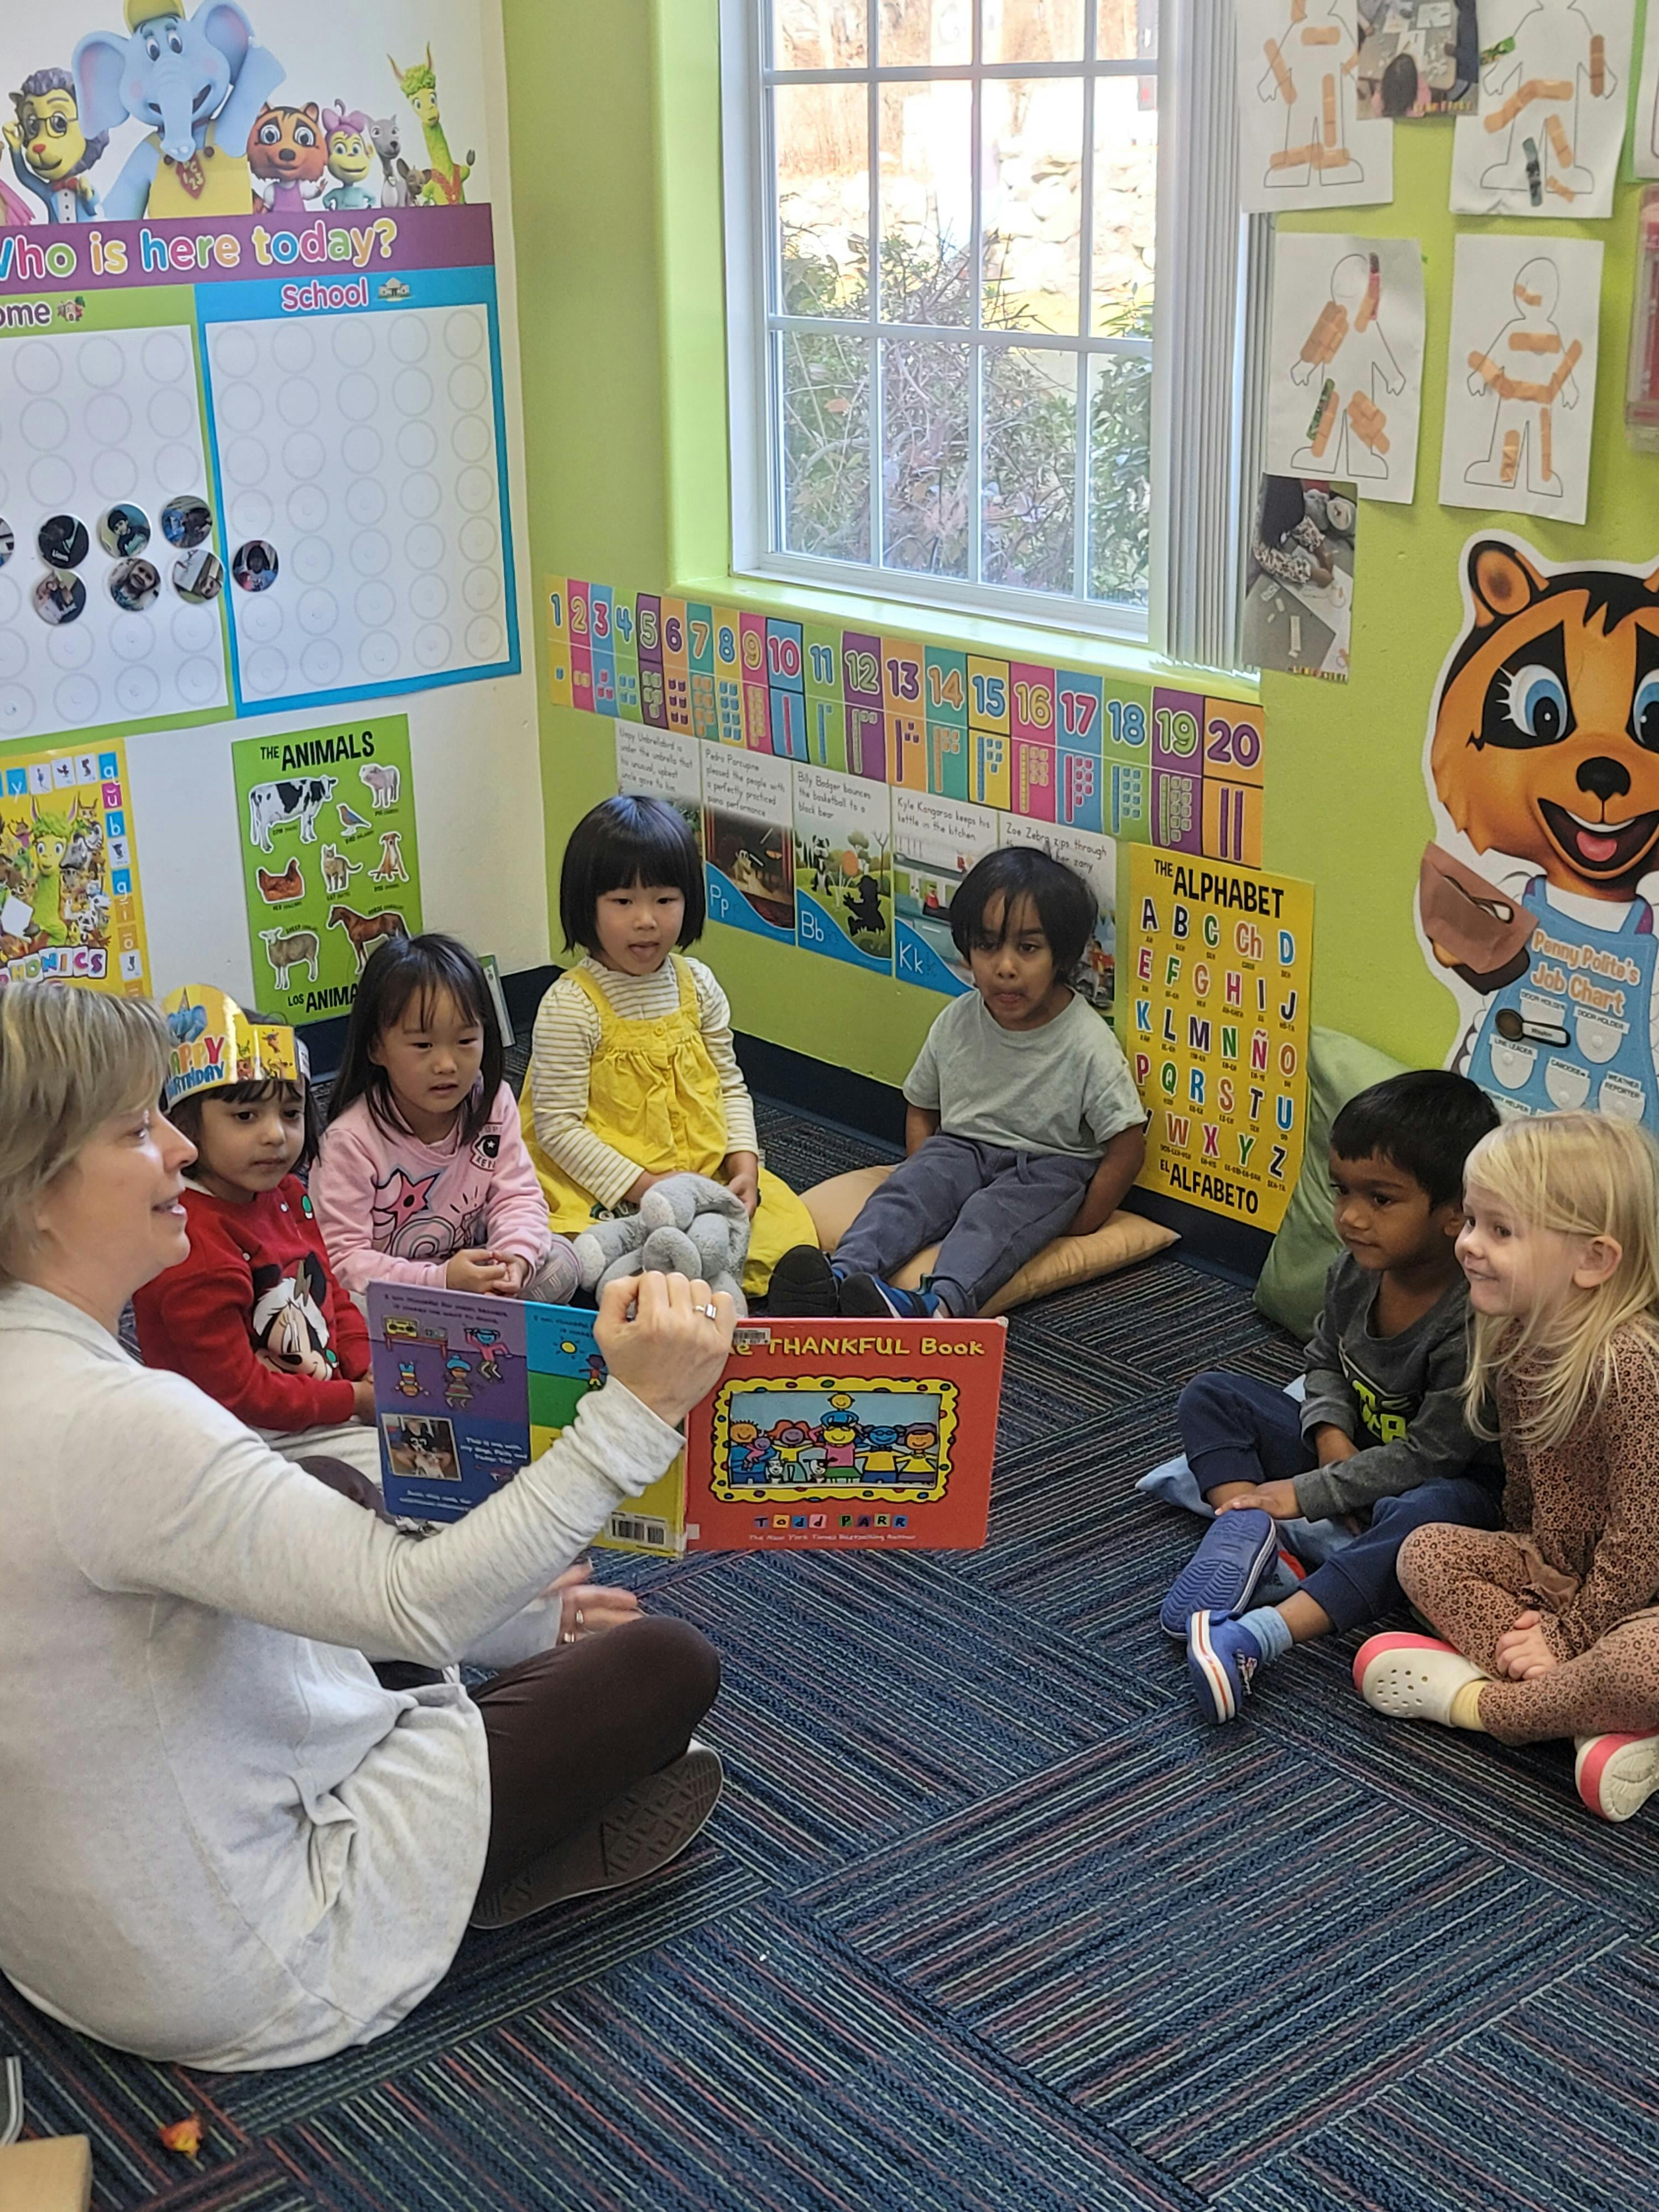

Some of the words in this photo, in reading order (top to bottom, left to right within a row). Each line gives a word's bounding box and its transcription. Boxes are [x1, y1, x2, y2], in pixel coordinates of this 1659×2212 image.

[0, 235, 77, 281] ho
[90, 232, 128, 275] is
[140, 228, 241, 272] here
[251, 218, 398, 268] today?
[281, 277, 368, 311] School
[551, 593, 562, 627] 1
[571, 596, 587, 634] 2
[593, 601, 609, 638] 3
[616, 606, 632, 643] 4
[640, 611, 659, 649] 5
[665, 616, 682, 653] 6
[690, 621, 709, 659] 7
[719, 627, 735, 664] 8
[742, 630, 762, 670] 9
[768, 635, 801, 677] 10
[810, 644, 834, 686] 11
[845, 650, 879, 695] 12
[886, 658, 920, 701] 13
[927, 665, 964, 711] 14
[972, 674, 1006, 718] 15
[1015, 681, 1051, 728] 16
[1060, 690, 1097, 737] 17
[1107, 700, 1145, 747] 18
[1155, 708, 1199, 758] 19
[1206, 718, 1261, 768] 20
[260, 746, 279, 760] THE
[281, 731, 374, 771] ANIMALS
[639, 747, 649, 757] the
[680, 759, 692, 768] that
[706, 748, 724, 763] Pedro
[639, 776, 653, 787] gave
[656, 779, 663, 789] to
[706, 765, 729, 779] pleased
[733, 771, 743, 782] the
[747, 776, 766, 791] people
[770, 781, 785, 792] with
[714, 782, 743, 801] perfectly
[746, 790, 776, 805] practiced
[798, 771, 812, 787] Billy
[816, 776, 840, 794] Badger
[843, 783, 871, 800] bounces
[727, 800, 766, 817] performance
[798, 802, 815, 815] black
[818, 807, 834, 820] bear
[799, 787, 810, 799] the
[813, 791, 847, 808] basketball
[850, 802, 858, 811] to
[898, 797, 914, 813] Kyle
[917, 803, 952, 820] Kangaroo
[956, 809, 976, 827] keeps
[979, 817, 990, 829] his
[111, 816, 121, 836] b
[898, 813, 919, 827] kettle
[933, 822, 945, 833] the
[948, 825, 977, 841] kitchen
[1006, 822, 1021, 836] Zoe
[1026, 827, 1049, 843] Zebra
[1054, 838, 1070, 849] zips
[1074, 840, 1107, 860] through
[1074, 859, 1093, 874] zany
[709, 884, 728, 918] Pp
[1154, 858, 1173, 878] THE
[1173, 866, 1284, 919] ALPHABET
[801, 911, 824, 942] Bb
[1141, 898, 1159, 931] A
[1172, 904, 1189, 938] B
[1204, 914, 1219, 948] C
[1235, 921, 1263, 961] Ch
[1279, 930, 1294, 965] D
[900, 941, 924, 974] Kk
[1532, 928, 1581, 970] Penny
[1581, 945, 1640, 987] Polite's
[288, 994, 304, 1006] LOS
[306, 985, 357, 1013] ANIMA
[1138, 947, 1152, 982] E
[1166, 955, 1181, 987] F
[1193, 963, 1210, 997] G
[1226, 971, 1241, 1006] H
[1258, 978, 1265, 1011] I
[1280, 991, 1297, 1021] J
[1531, 962, 1567, 994] Job
[1568, 974, 1625, 1016] Chart
[1578, 1009, 1596, 1019] DOOR
[1598, 1016, 1624, 1030] HOLDER
[1136, 1000, 1152, 1032] K
[1164, 1008, 1176, 1042] L
[1189, 1016, 1210, 1053] M
[1222, 1027, 1238, 1059] N
[1251, 1029, 1268, 1071] Ñ
[1279, 1044, 1297, 1076] O
[1494, 1037, 1507, 1047] LINE
[1509, 1042, 1533, 1055] LEADER
[170, 1037, 224, 1074] APPY
[1136, 1053, 1150, 1087] P
[1161, 1061, 1177, 1097] Q
[1190, 1068, 1205, 1104] R
[1219, 1078, 1234, 1113] S
[1250, 1087, 1264, 1120] T
[1277, 1095, 1293, 1131] U
[1605, 1082, 1640, 1098] REPORTER
[1608, 1074, 1640, 1088] WEATHER
[1167, 1112, 1189, 1147] W
[1203, 1124, 1219, 1158] X
[1238, 1134, 1255, 1167] Y
[1269, 1145, 1287, 1180] Z
[1160, 1159, 1170, 1173] EL
[1170, 1164, 1258, 1214] ALFABETO
[769, 1338, 910, 1355] THANKFUL
[921, 1337, 985, 1355] Book
[841, 1515, 906, 1527] PARR
